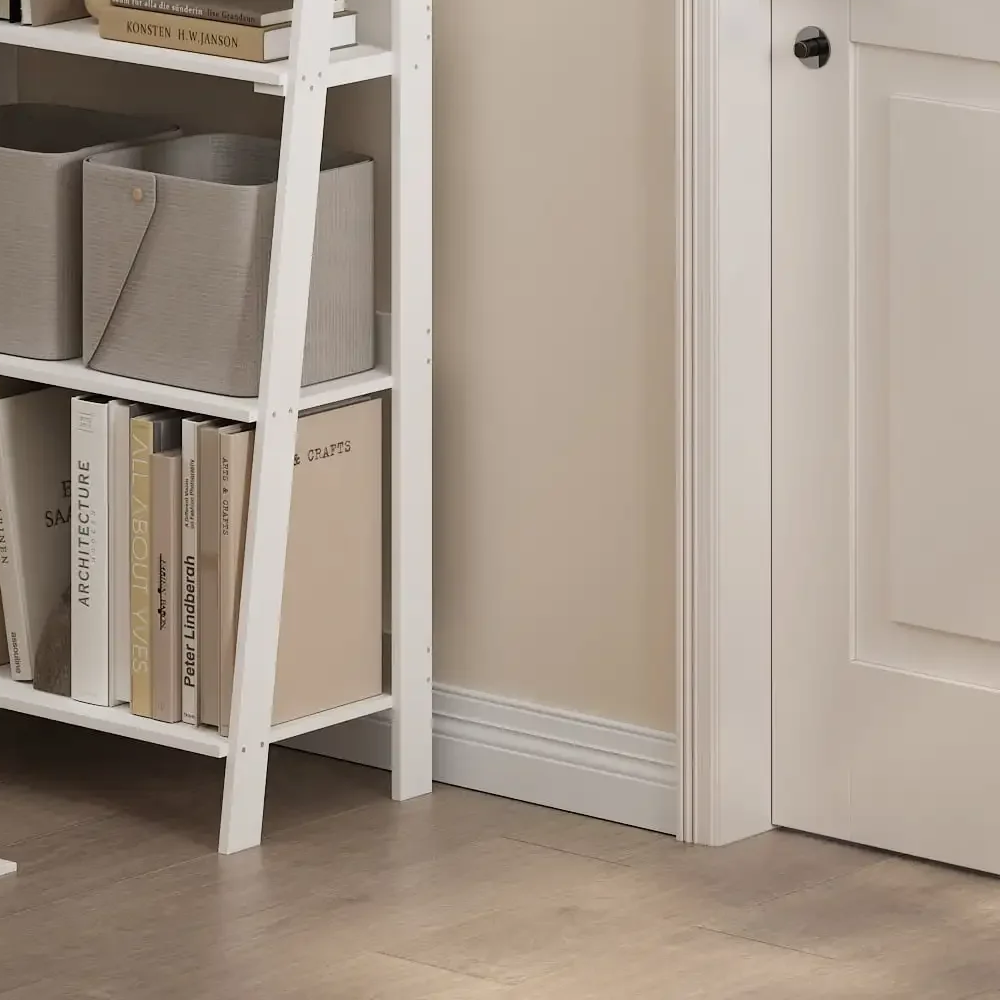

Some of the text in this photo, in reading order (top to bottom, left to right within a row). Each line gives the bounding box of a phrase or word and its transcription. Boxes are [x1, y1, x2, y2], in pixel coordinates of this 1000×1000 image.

[159, 0, 170, 10] die
[126, 20, 171, 38] KONSTEN
[307, 440, 351, 462] CRAFTS
[222, 487, 229, 495] &
[78, 459, 91, 607] ARCHITECTURE
[132, 494, 149, 593] ABOUT
[132, 611, 149, 674] YVES
[184, 644, 195, 688] Peter
